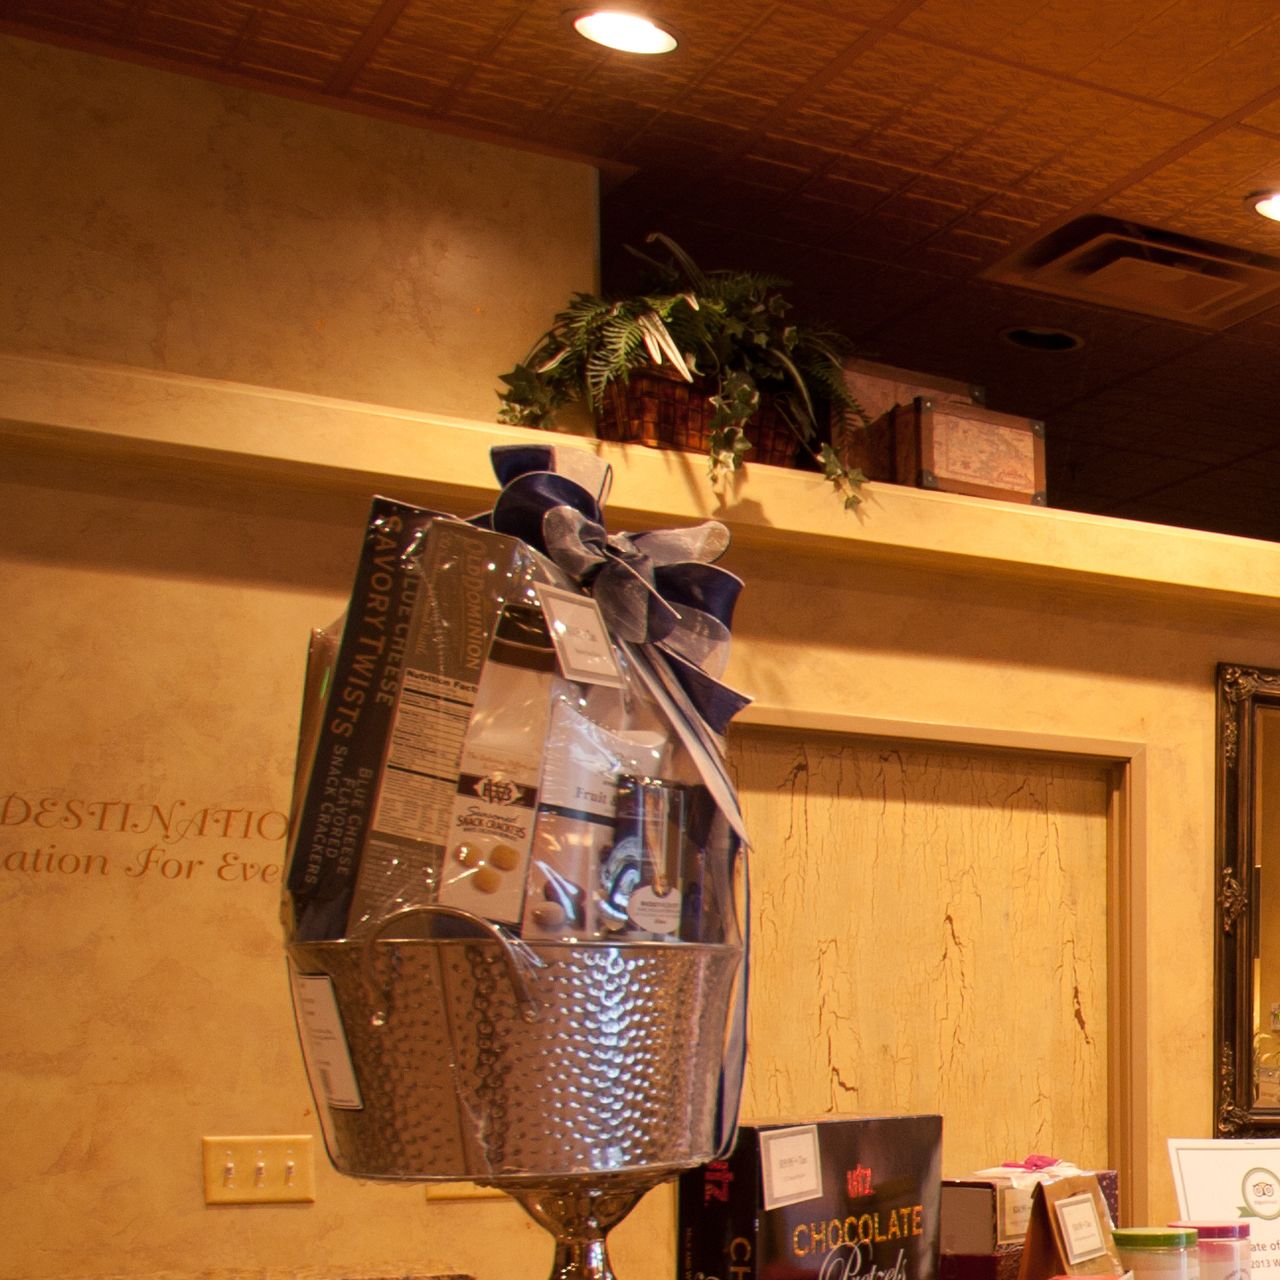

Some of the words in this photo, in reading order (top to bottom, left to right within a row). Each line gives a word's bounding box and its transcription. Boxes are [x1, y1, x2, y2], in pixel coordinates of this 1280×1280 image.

[124, 842, 204, 880] For
[217, 852, 285, 884] Eve
[793, 1204, 924, 1257] CHOCOLATE
[1271, 1239, 1280, 1251] of
[1251, 1259, 1271, 1269] 2013
